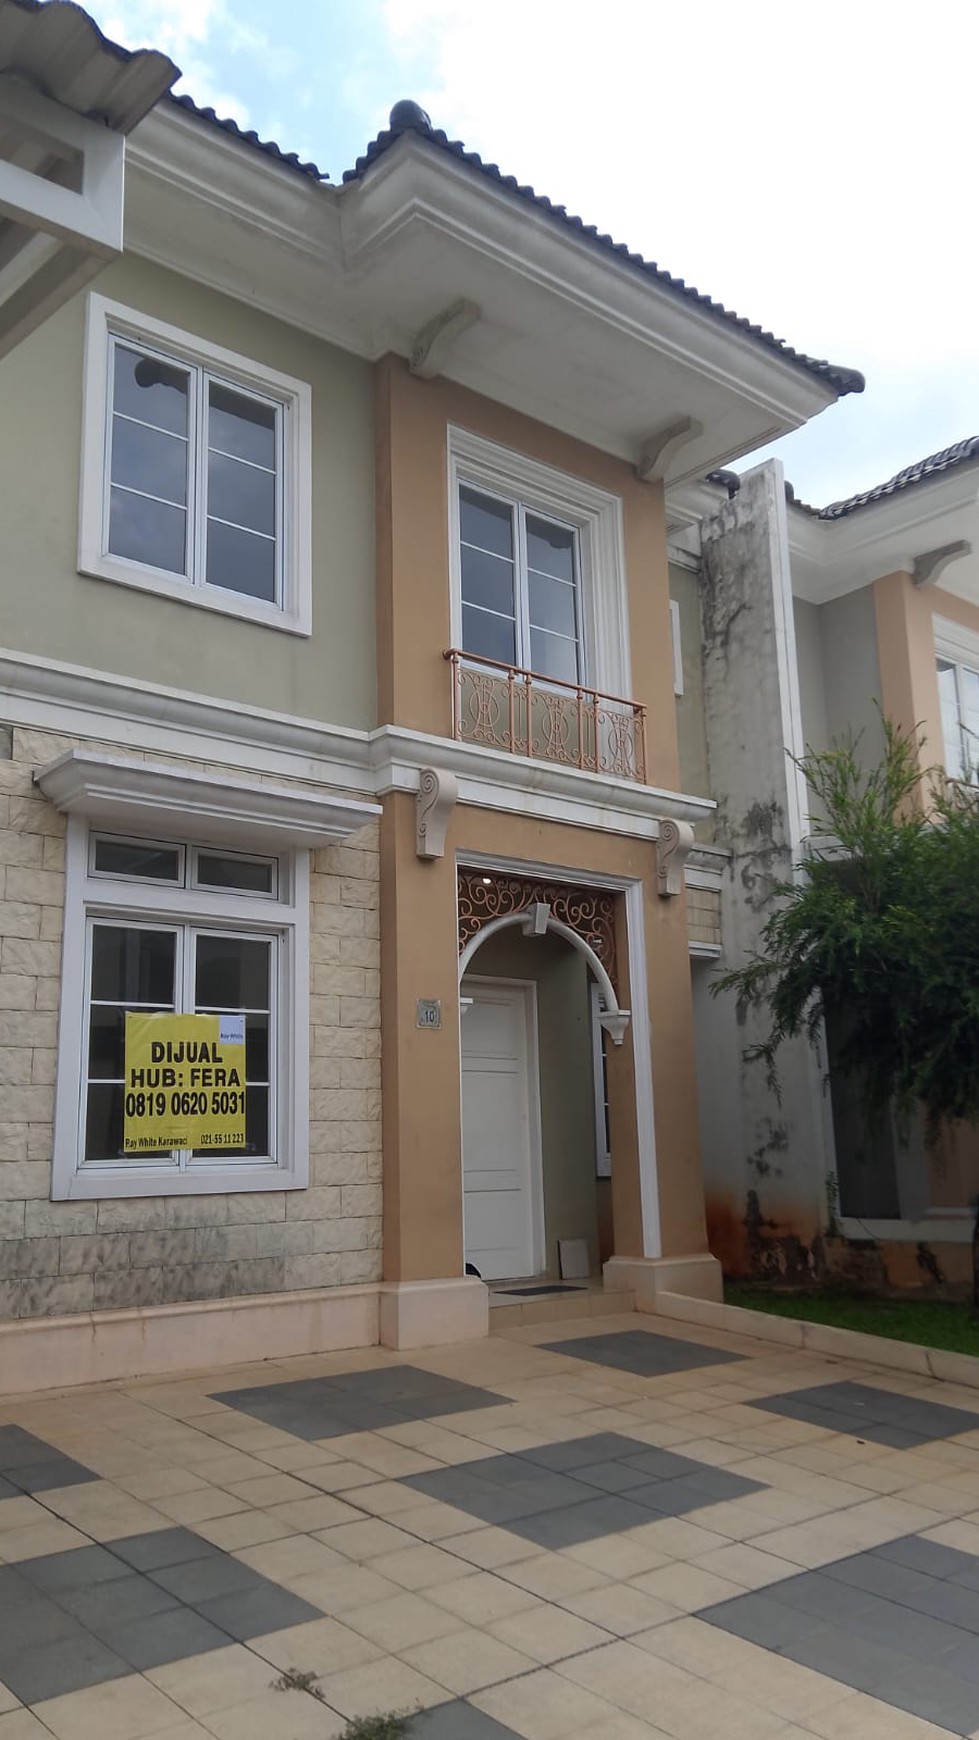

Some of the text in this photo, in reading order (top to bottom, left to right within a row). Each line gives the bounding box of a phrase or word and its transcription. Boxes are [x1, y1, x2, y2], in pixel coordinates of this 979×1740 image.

[425, 1010, 435, 1023] 10
[151, 1041, 223, 1063] DIJUAL
[131, 1068, 241, 1088] HUB: FERA
[126, 1091, 245, 1117] 0819 0620 5031
[125, 1138, 137, 1150] Ray
[138, 1136, 158, 1148] White
